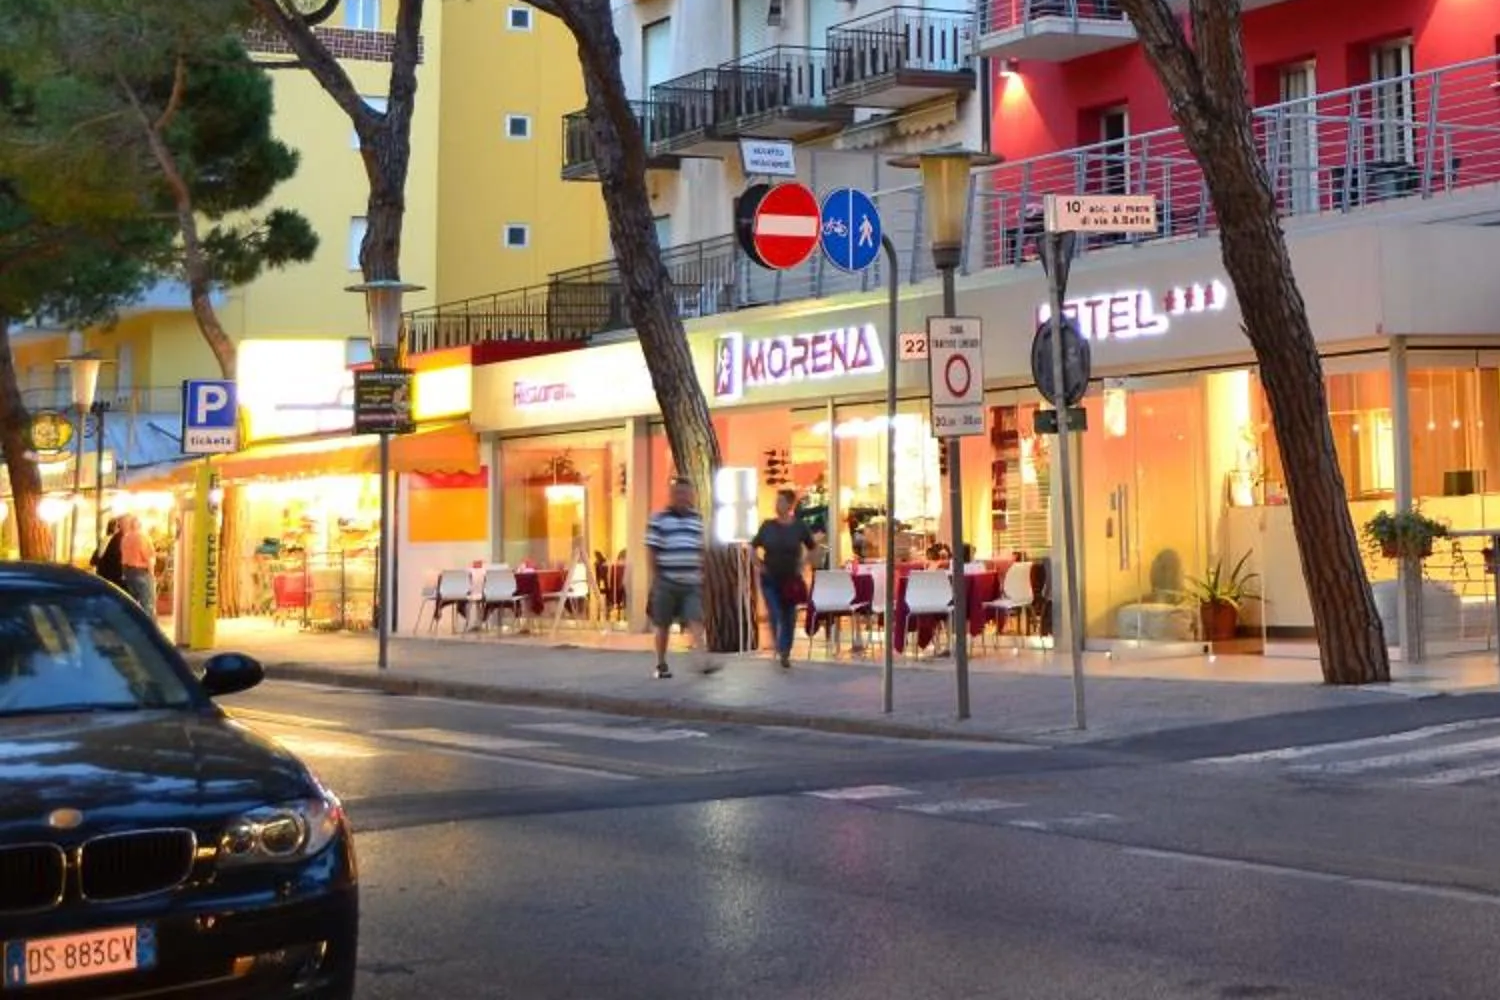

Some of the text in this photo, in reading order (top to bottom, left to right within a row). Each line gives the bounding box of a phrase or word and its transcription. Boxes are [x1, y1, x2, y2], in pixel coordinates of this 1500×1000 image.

[1093, 216, 1109, 226] via
[743, 325, 876, 382] MORENA
[904, 338, 927, 354] 22
[196, 384, 229, 425] P
[190, 434, 232, 447] tickets
[28, 945, 57, 976] DS
